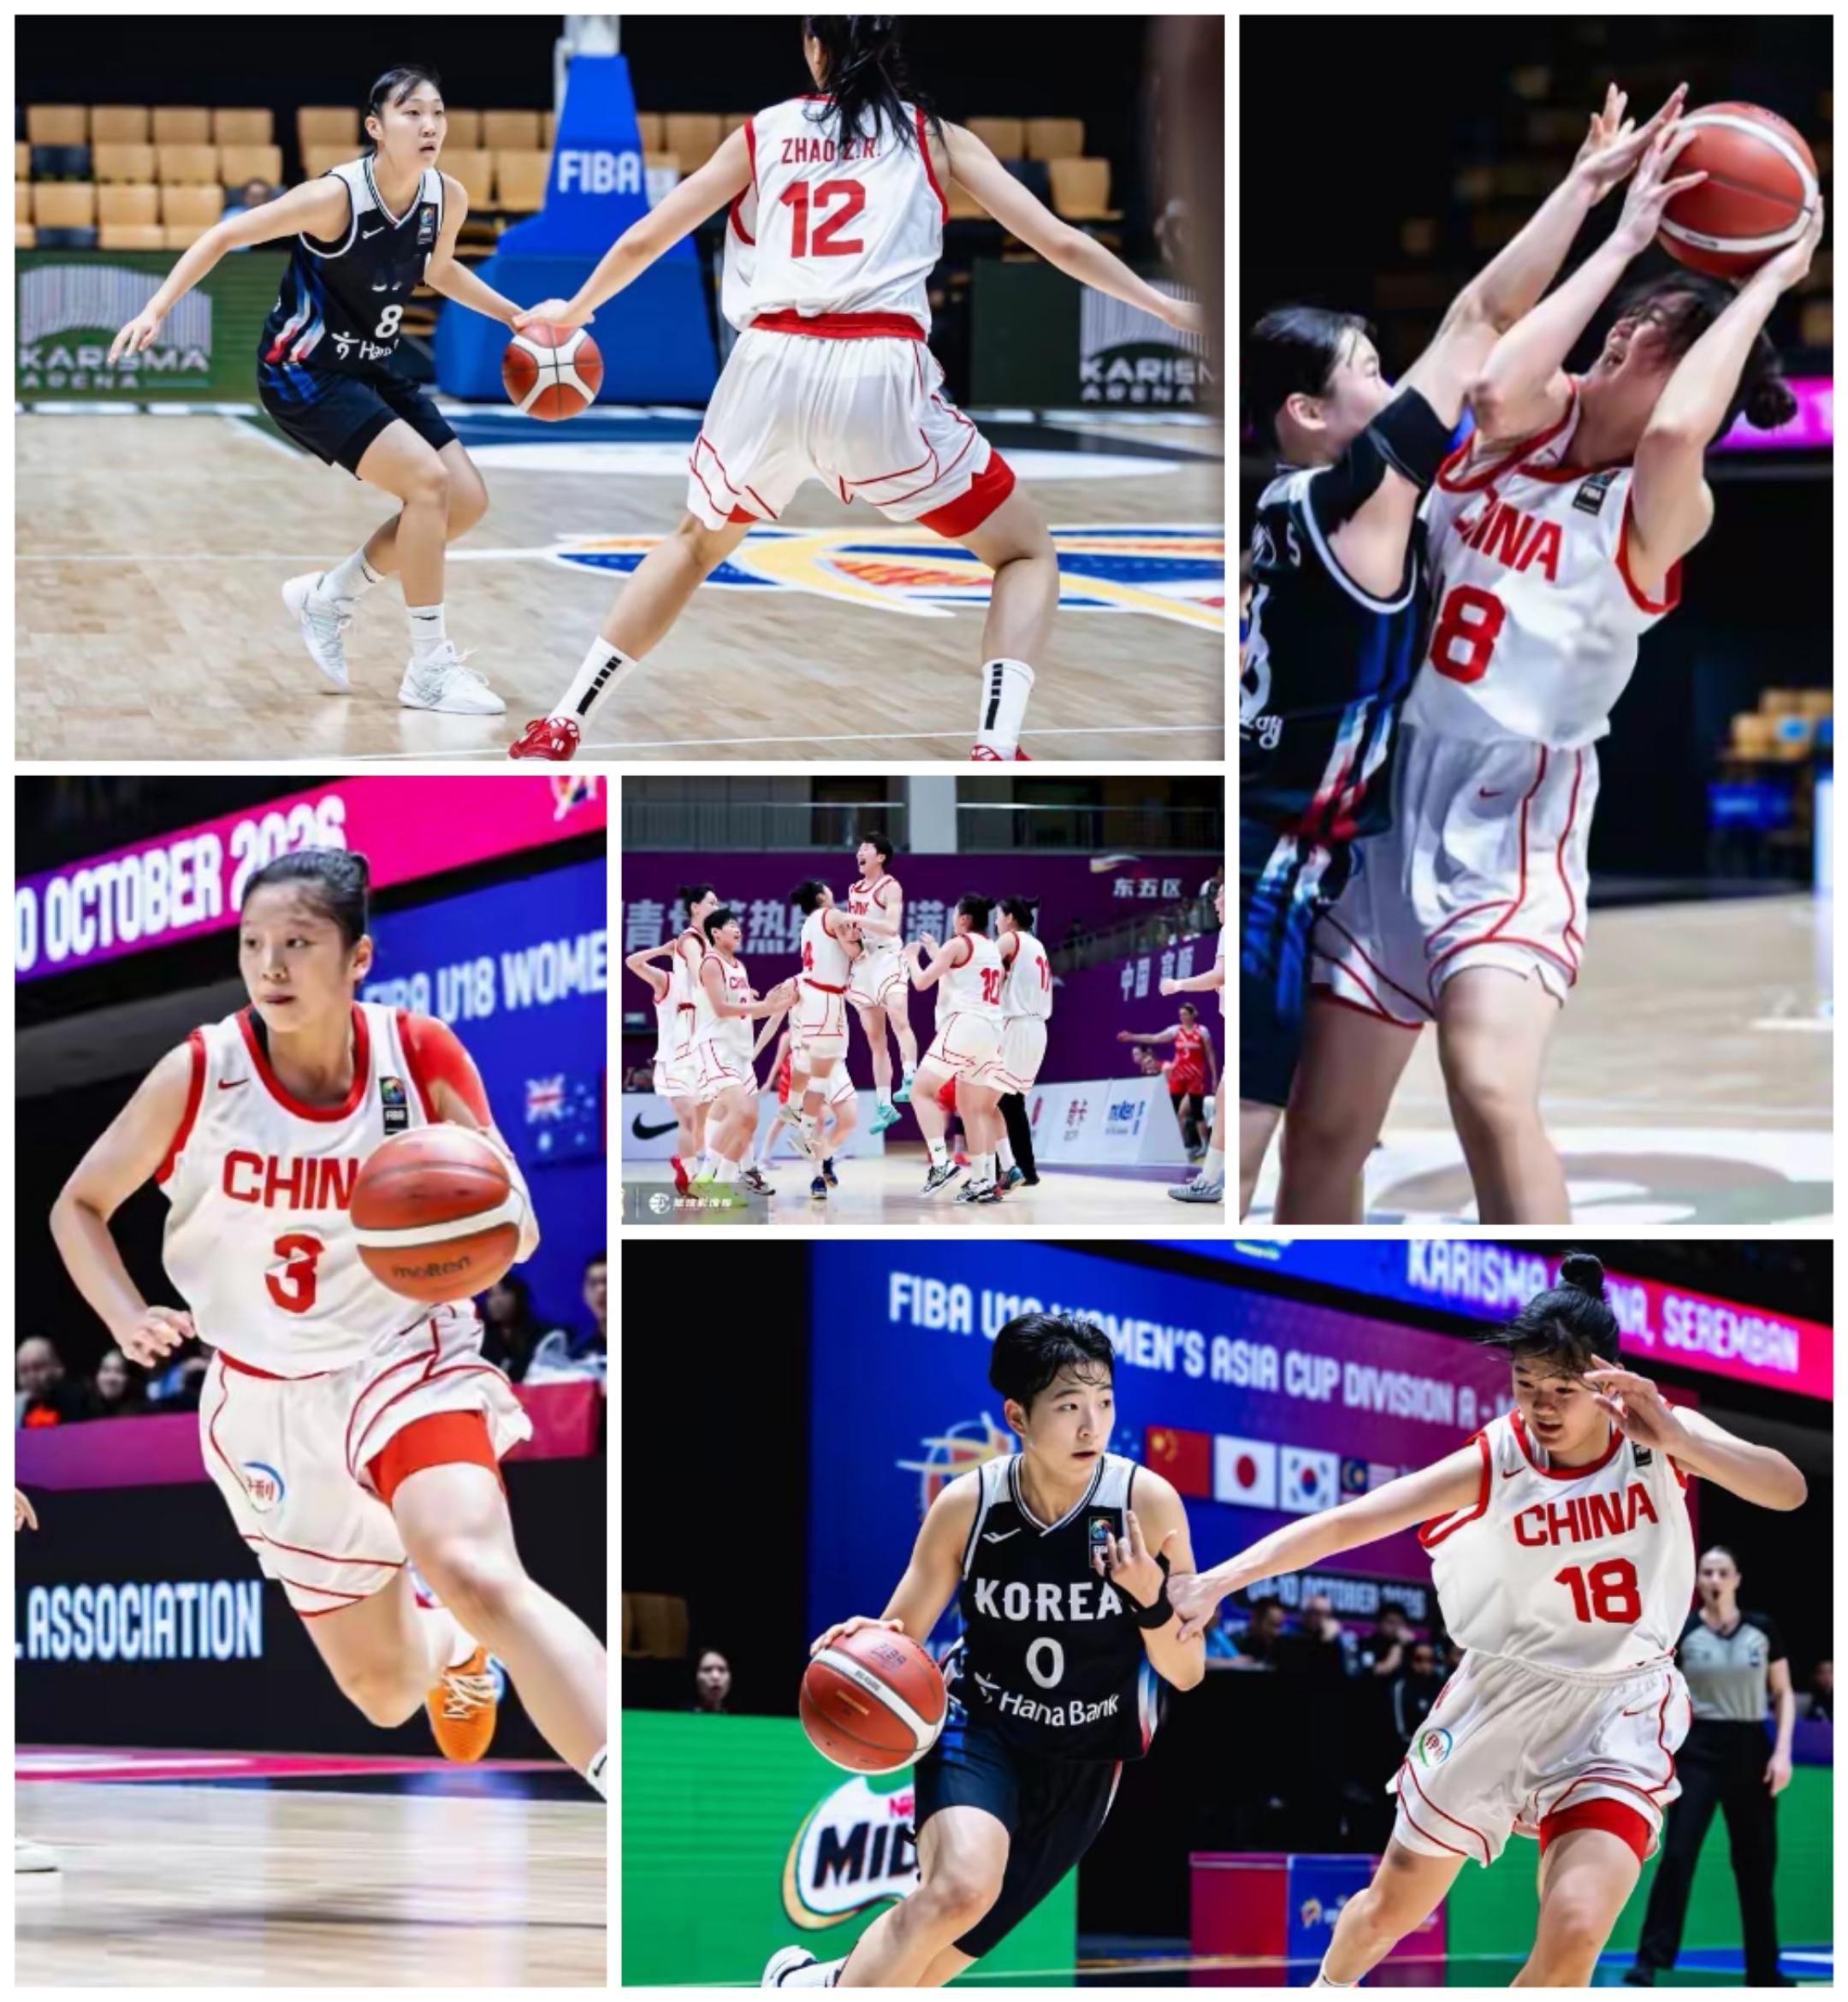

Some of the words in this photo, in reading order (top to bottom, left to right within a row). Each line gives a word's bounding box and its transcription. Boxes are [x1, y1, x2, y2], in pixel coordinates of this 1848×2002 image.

[558, 150, 641, 195] FIBA
[781, 137, 836, 164] ZHAO
[779, 179, 866, 258] 12
[375, 304, 403, 339] 8
[19, 345, 209, 372] KARSMA
[1430, 583, 1506, 684] 8
[44, 832, 223, 962] OCTOBER
[1114, 877, 1183, 898] 东五区
[437, 956, 496, 1025] U18
[264, 1233, 325, 1314] 3
[889, 1271, 973, 1336] FIBA
[1211, 1335, 1278, 1392] ASIA
[1285, 1349, 1341, 1402] CUP
[1343, 1360, 1454, 1425] DIVISION
[1457, 1385, 1477, 1430] A
[1513, 1482, 1658, 1546] CHINA
[27, 1579, 262, 1661] ASSOCIATION
[974, 1578, 1123, 1621] KOREA
[1555, 1557, 1642, 1625] 18
[1026, 1637, 1064, 1689] 0
[998, 1691, 1065, 1727] Hana
[1069, 1693, 1120, 1727] Bank
